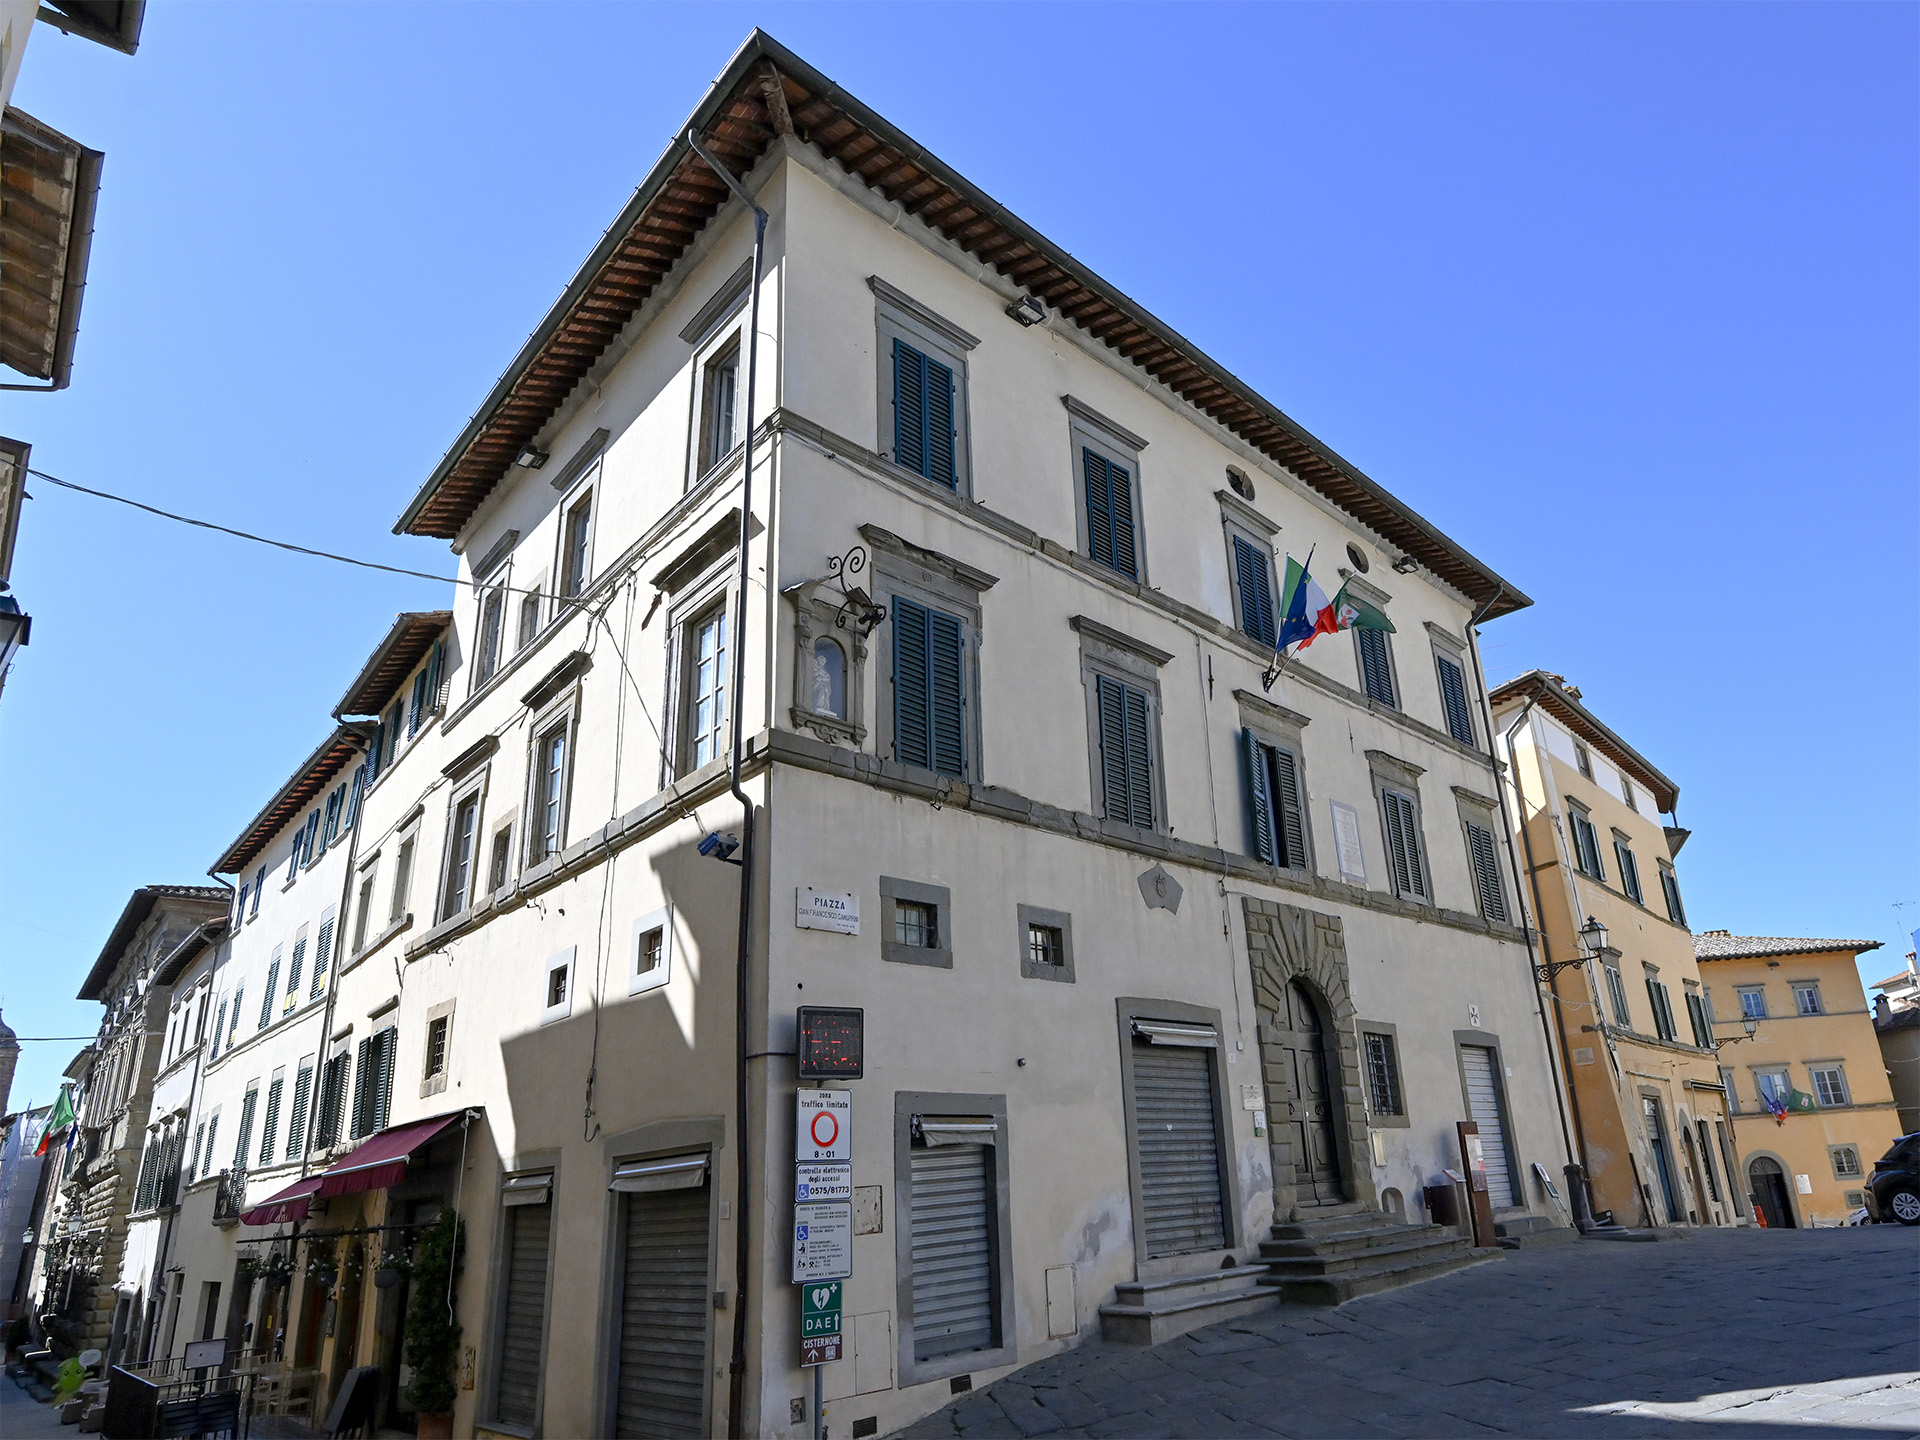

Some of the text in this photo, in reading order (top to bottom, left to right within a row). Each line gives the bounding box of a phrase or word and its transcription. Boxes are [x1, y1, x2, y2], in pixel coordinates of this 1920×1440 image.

[814, 898, 845, 910] PIAZZA
[801, 1100, 823, 1108] traffico
[799, 1167, 821, 1175] controllo
[808, 1175, 820, 1183] degli
[810, 1186, 849, 1195] 0575/81773
[806, 1317, 831, 1330] DAE
[803, 1336, 840, 1349] CISTERNONE
